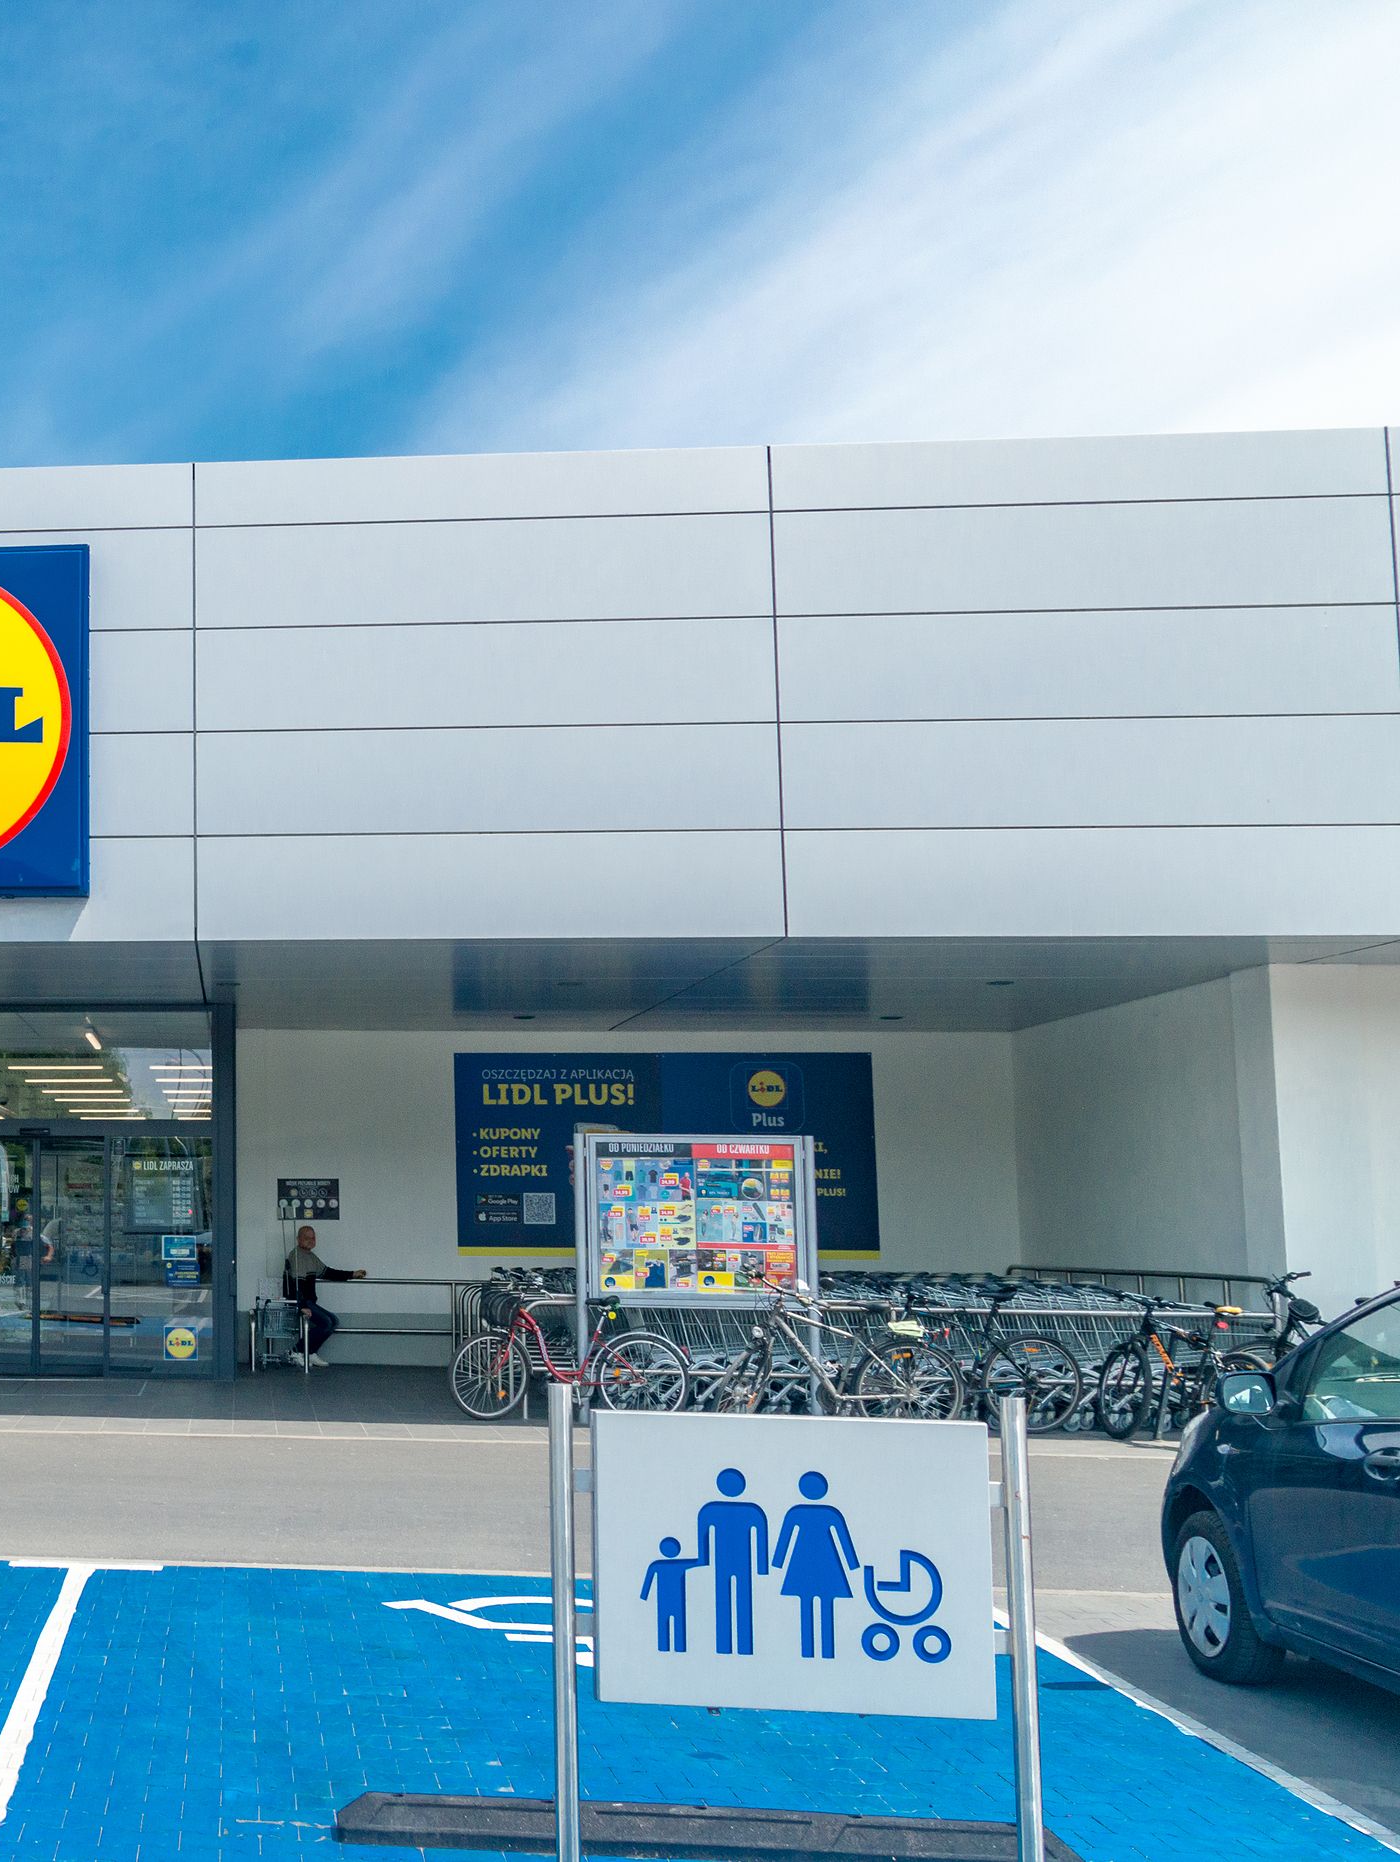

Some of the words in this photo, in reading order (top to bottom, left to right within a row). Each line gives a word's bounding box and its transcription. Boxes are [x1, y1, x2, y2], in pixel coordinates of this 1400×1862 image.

[481, 1068, 557, 1082] OSZCZĘDZAJ
[560, 1069, 567, 1080] Z
[570, 1068, 635, 1082] APLIKACJĄ
[482, 1083, 548, 1105] LIDL
[553, 1083, 635, 1105] PLUS!
[751, 1113, 785, 1127] Plus
[479, 1127, 541, 1140] KUPONY
[479, 1146, 538, 1159] OFERTY
[608, 1143, 620, 1153] OD
[621, 1143, 674, 1153] PONIEDZIAŁKU
[729, 1144, 770, 1155] CZWARTKU
[143, 1160, 158, 1171] LIDL
[159, 1160, 194, 1171] ZAPRASZA
[480, 1164, 548, 1177] ZDRAPKI
[816, 1187, 847, 1197] PLUS!
